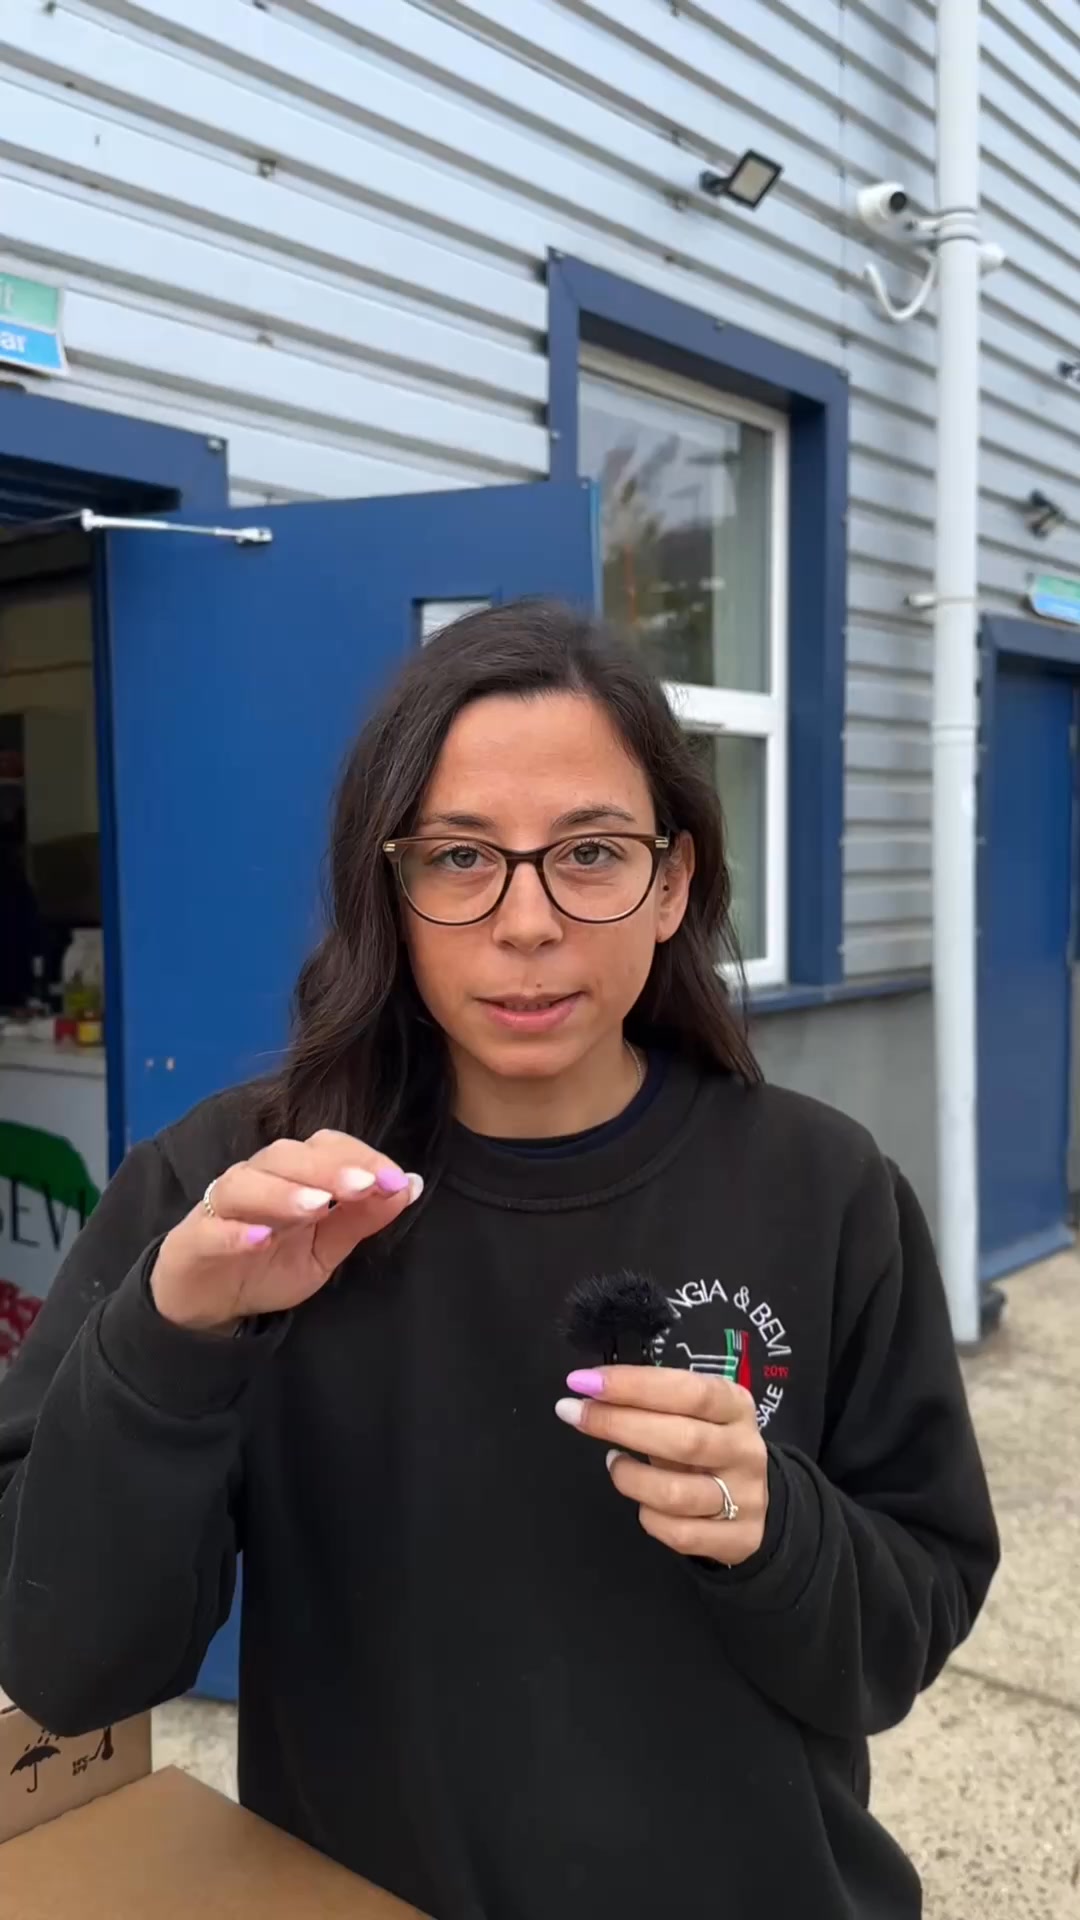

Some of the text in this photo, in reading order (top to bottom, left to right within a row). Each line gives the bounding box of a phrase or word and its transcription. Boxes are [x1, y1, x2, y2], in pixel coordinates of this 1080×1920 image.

[0, 1175, 87, 1252] EVI
[733, 1286, 750, 1313] &
[750, 1302, 792, 1357] BEVI
[756, 1383, 784, 1430] SALE
